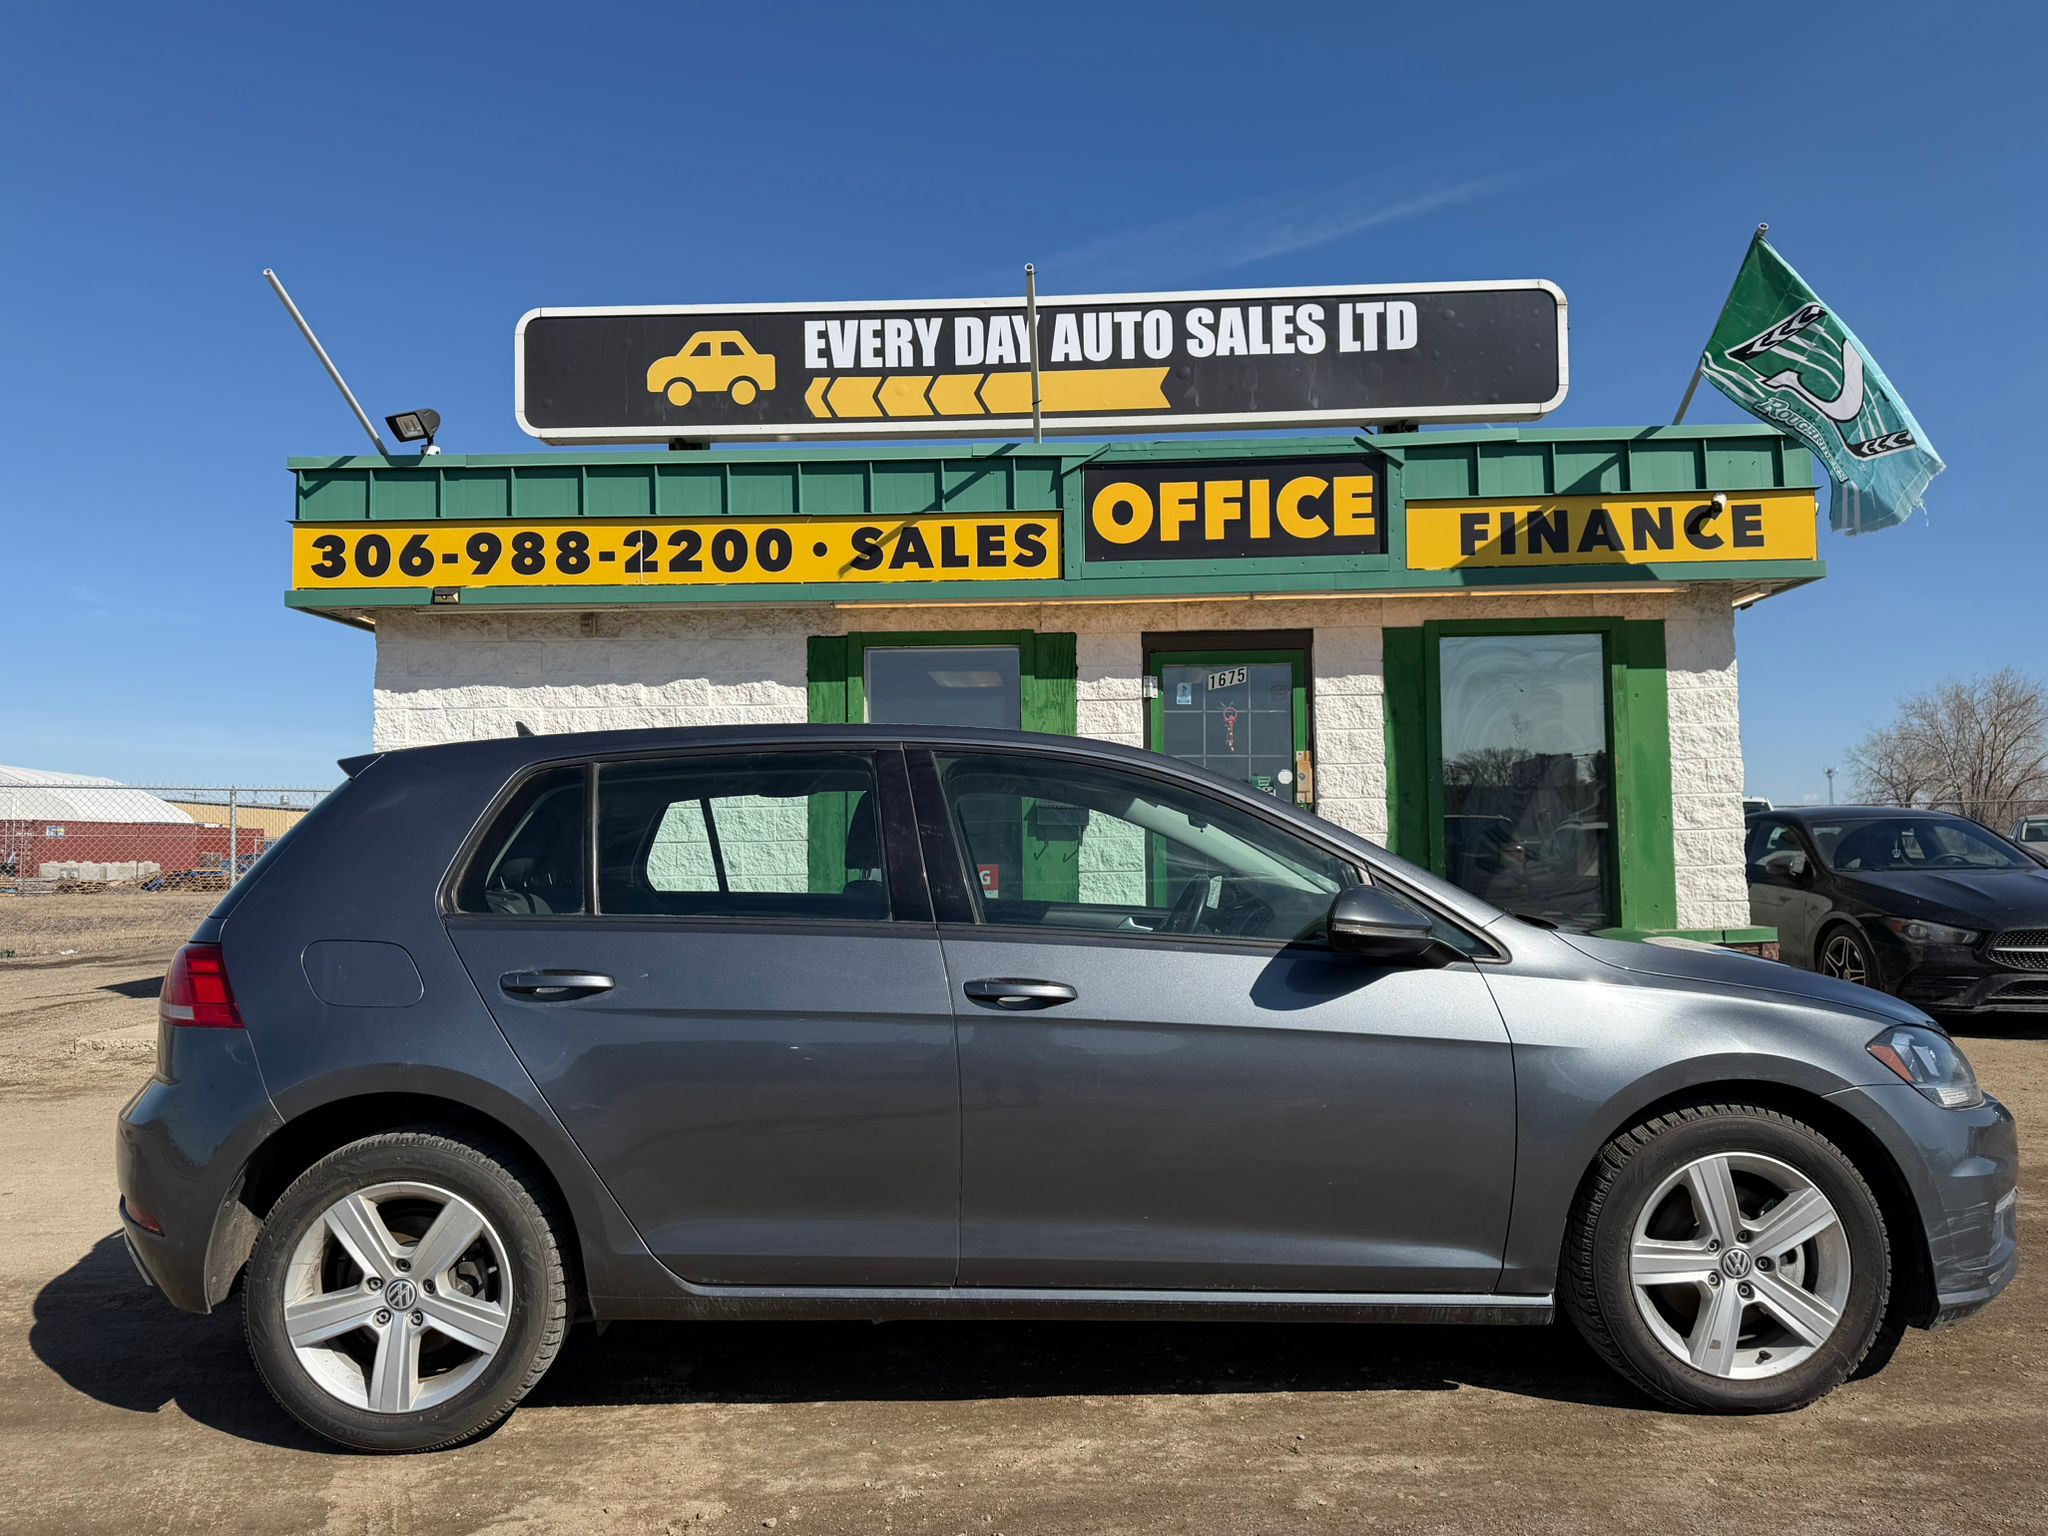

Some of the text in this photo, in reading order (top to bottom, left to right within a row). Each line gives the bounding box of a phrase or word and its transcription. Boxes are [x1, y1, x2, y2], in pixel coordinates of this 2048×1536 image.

[804, 300, 1418, 369] EVERY DAY AUTO SALES LTD
[1092, 475, 1376, 545] OFFICE
[1459, 503, 1765, 557] FINANCE
[310, 523, 1048, 578] 306-988-2200 SALES
[1210, 667, 1246, 689] 1675
